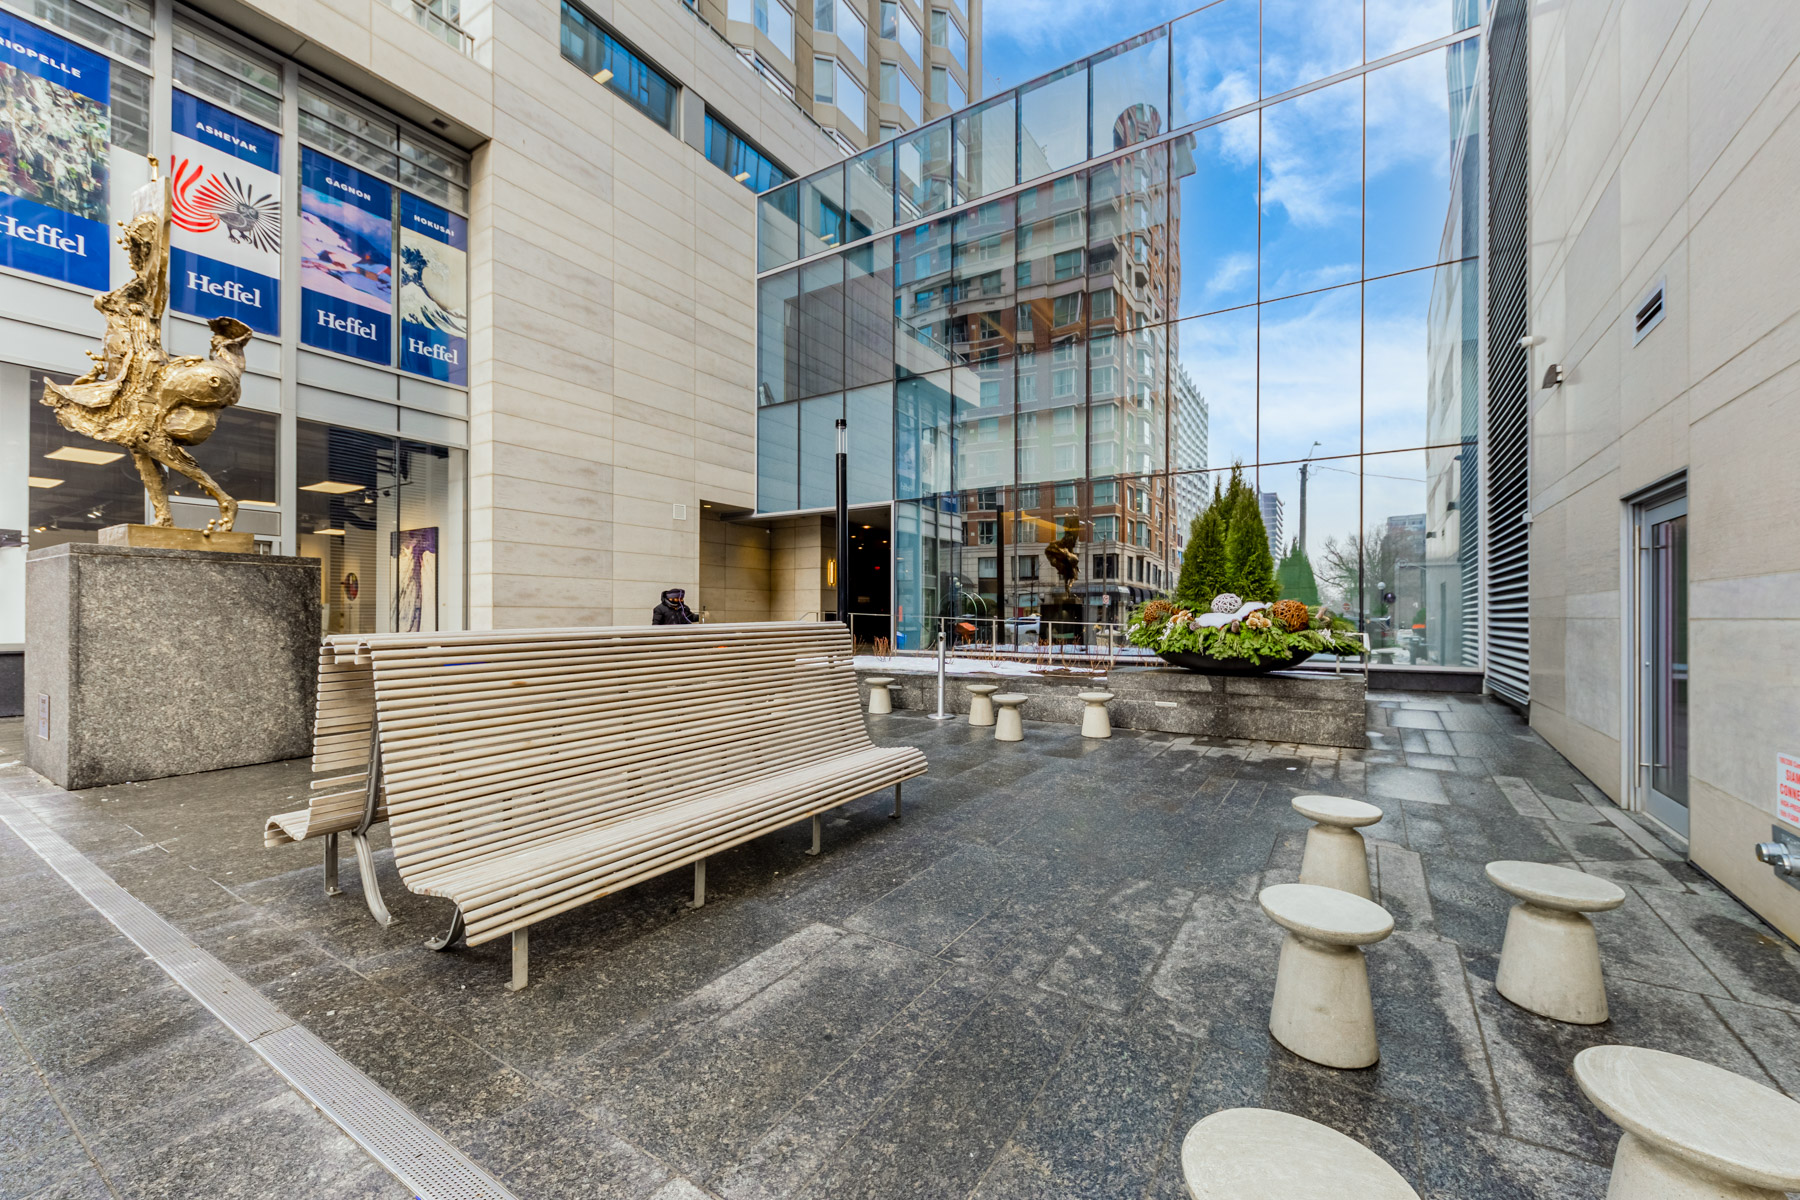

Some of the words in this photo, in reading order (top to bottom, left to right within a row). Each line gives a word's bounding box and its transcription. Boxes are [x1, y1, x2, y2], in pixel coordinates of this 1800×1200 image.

[195, 121, 257, 153] ASHEVAK
[325, 177, 371, 201] GAGNON
[0, 215, 87, 257] Heffel
[414, 214, 455, 237] HOKUSAI
[187, 270, 262, 308] Heffel
[317, 309, 377, 341] Heffel
[409, 337, 459, 365] Heffel
